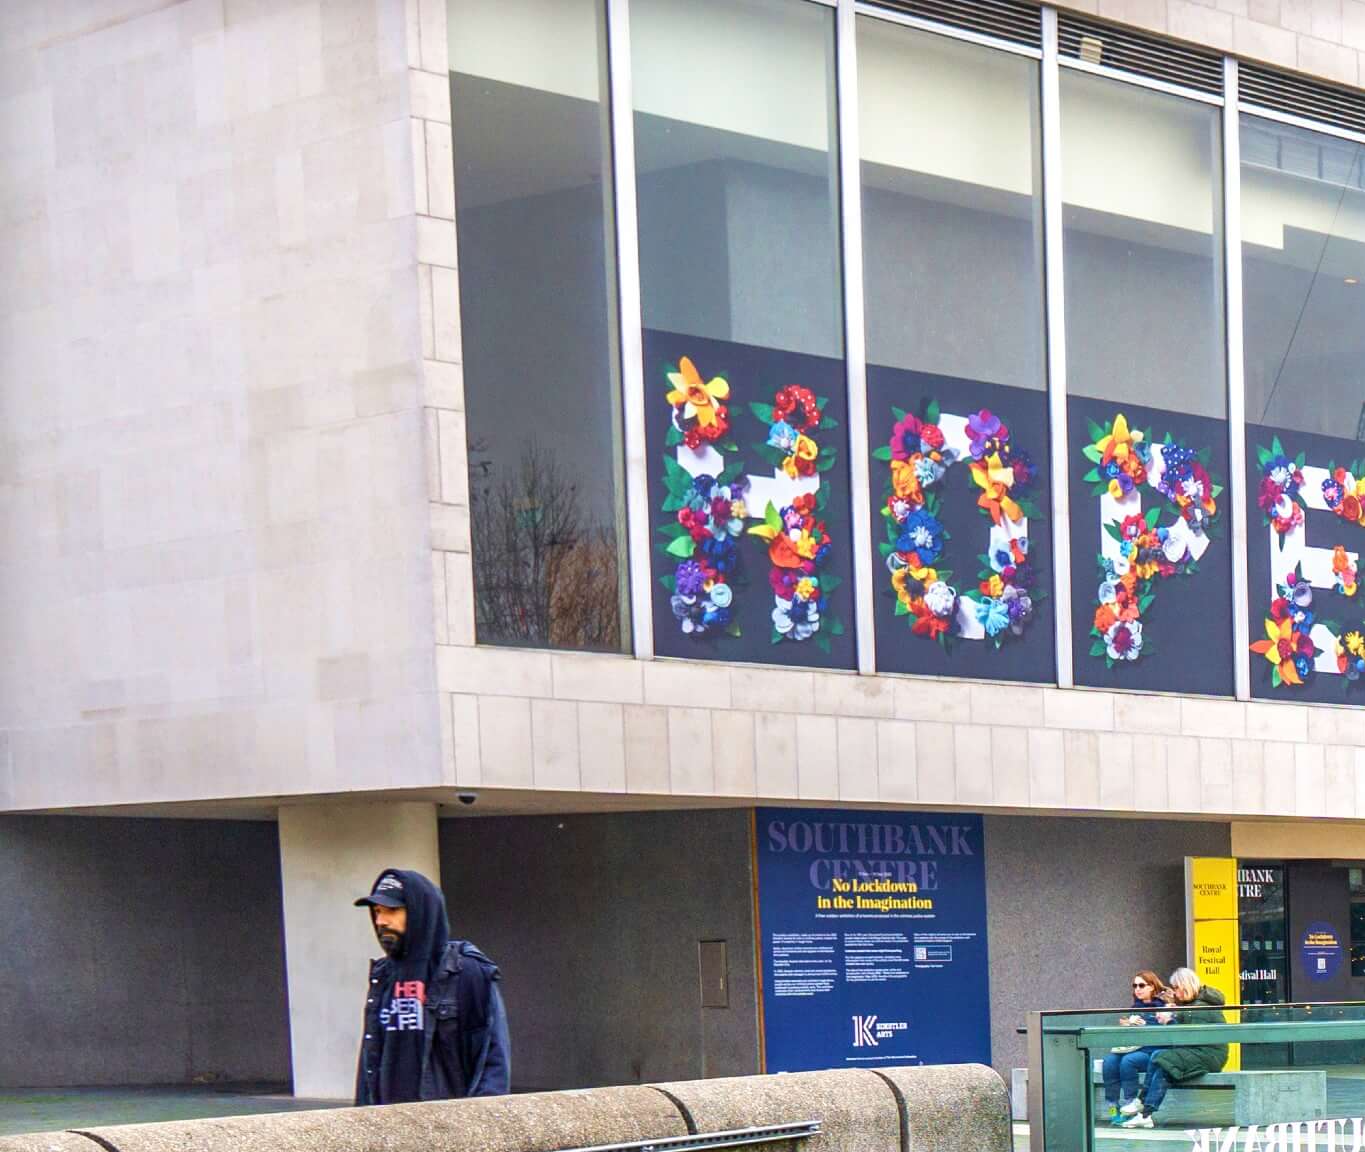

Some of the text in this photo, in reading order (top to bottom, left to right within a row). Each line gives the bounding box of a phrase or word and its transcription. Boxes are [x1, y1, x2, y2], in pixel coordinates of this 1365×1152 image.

[768, 820, 974, 855] SOUTHBANK
[809, 859, 938, 890] CENTRE
[832, 879, 917, 893] No Lockdown
[818, 896, 932, 912] in the Imagination
[1202, 945, 1222, 954] Royal
[1199, 956, 1226, 965] Festival
[1205, 967, 1220, 975] Hall
[1260, 969, 1277, 980] Hall
